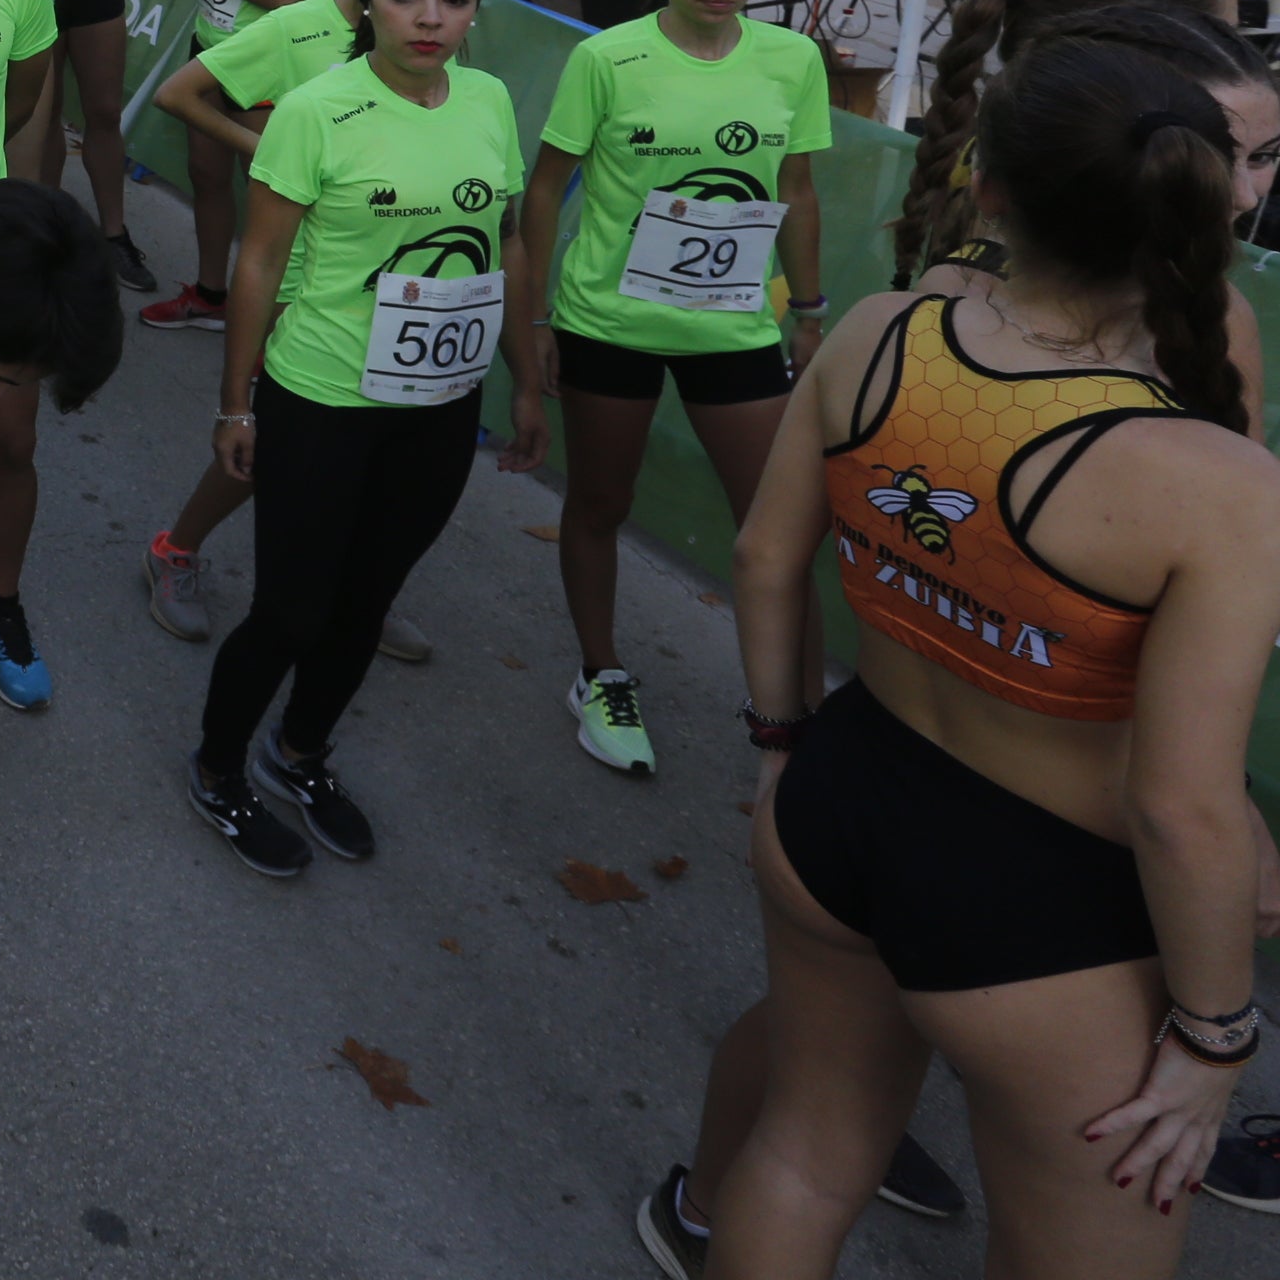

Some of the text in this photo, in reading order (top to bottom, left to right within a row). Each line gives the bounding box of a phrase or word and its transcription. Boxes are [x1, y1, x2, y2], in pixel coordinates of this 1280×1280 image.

[291, 32, 320, 44] luanvi
[332, 105, 365, 125] luanvi
[634, 146, 702, 157] IBERDROLA
[374, 206, 441, 218] IBERDROLA
[670, 236, 738, 278] 29
[392, 317, 486, 368] 560
[878, 543, 1007, 625] Deportivo
[874, 557, 1055, 669] ZUBIA
